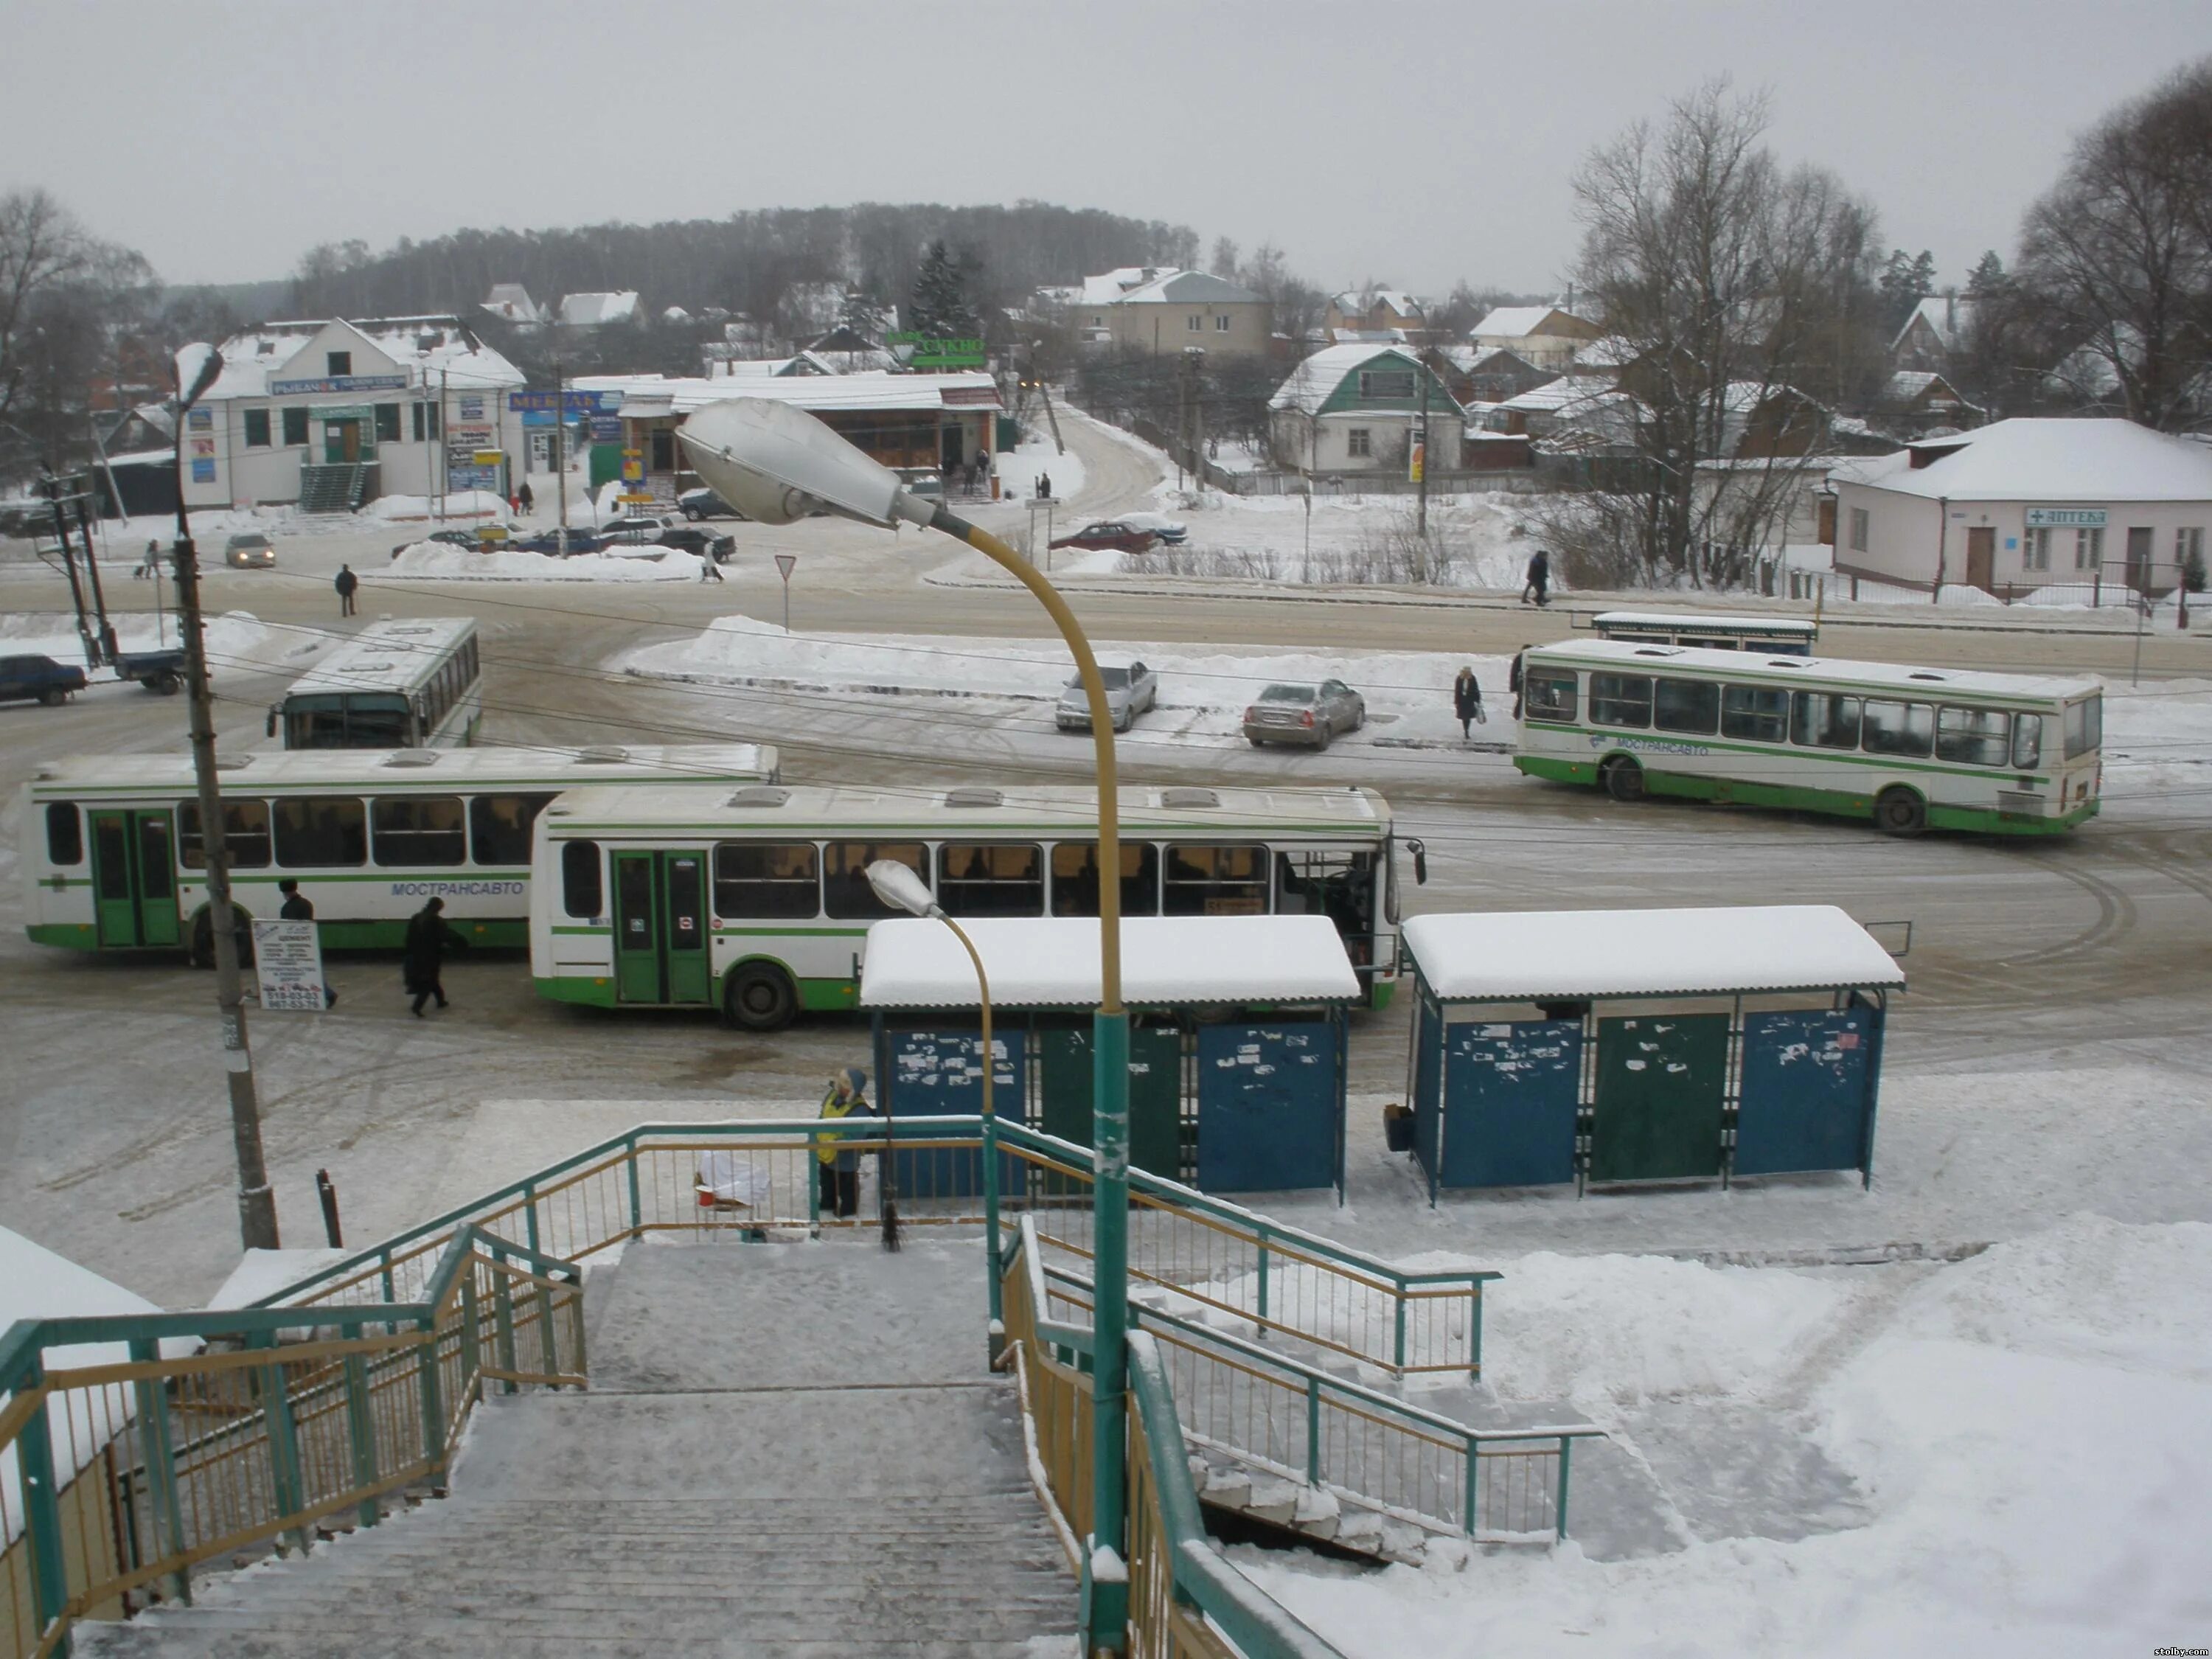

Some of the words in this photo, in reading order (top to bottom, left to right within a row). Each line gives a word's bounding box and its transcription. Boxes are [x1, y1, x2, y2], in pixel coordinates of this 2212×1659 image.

[2046, 511, 2107, 523] АПТЕКА
[1616, 737, 1708, 756] МОСТРАНСАВТО
[391, 882, 524, 896] МОСТРАНСАВТО
